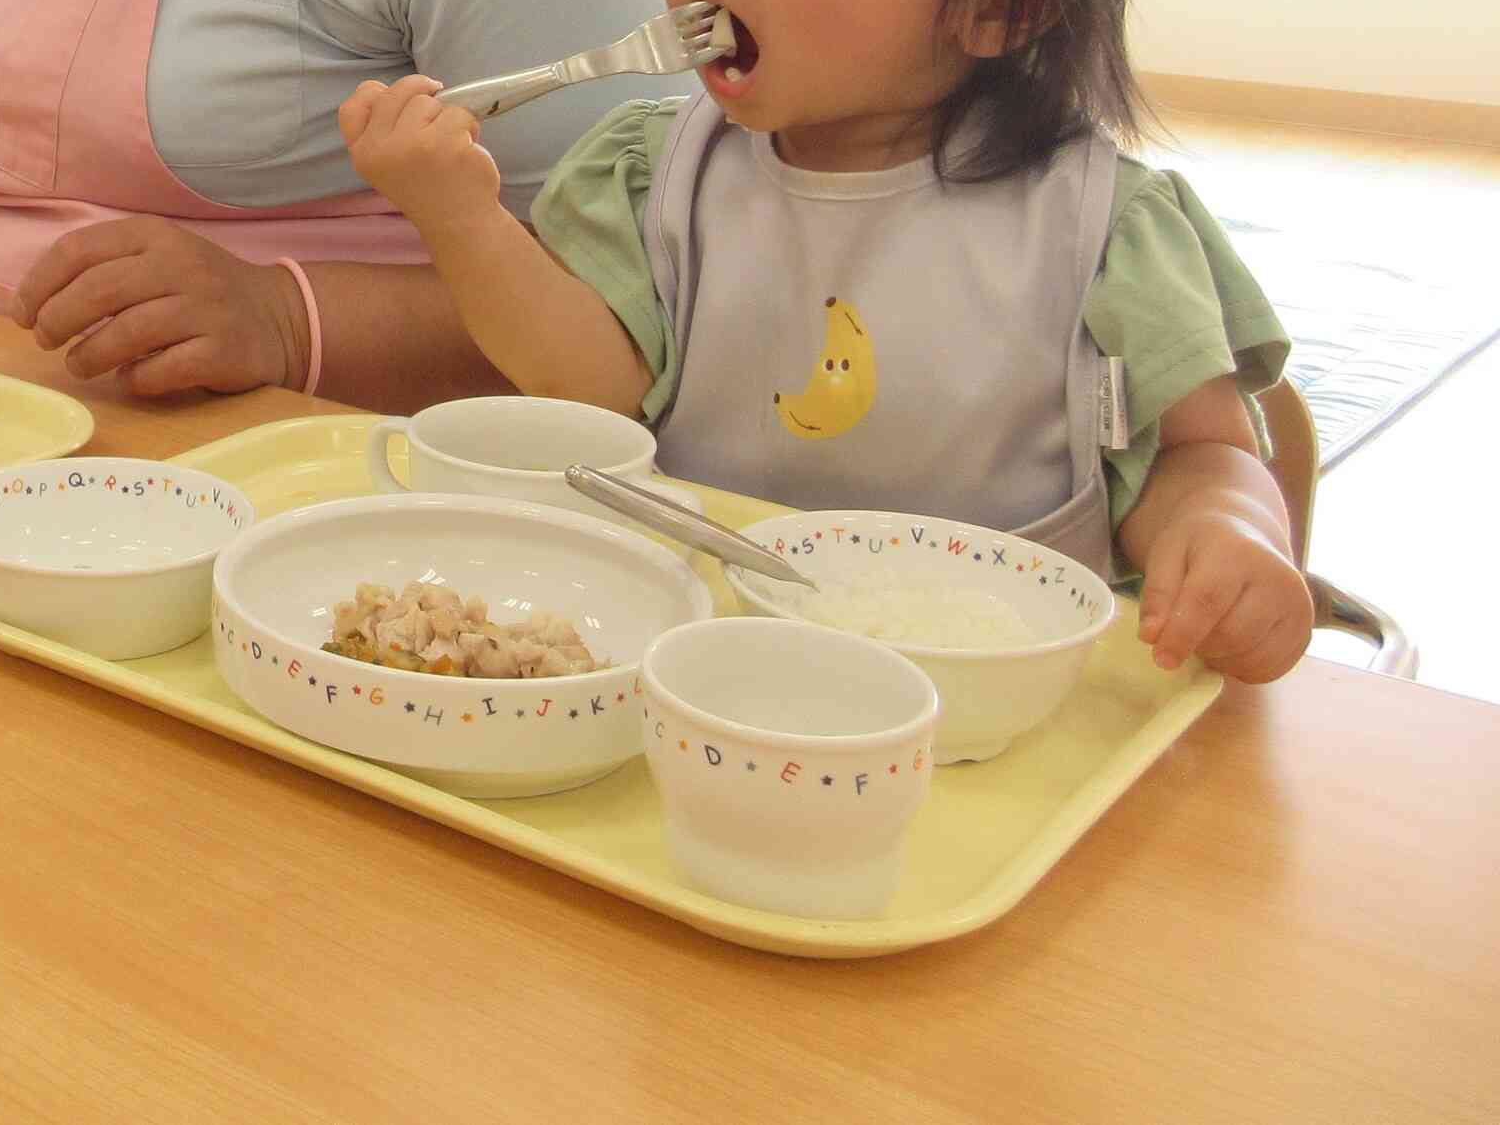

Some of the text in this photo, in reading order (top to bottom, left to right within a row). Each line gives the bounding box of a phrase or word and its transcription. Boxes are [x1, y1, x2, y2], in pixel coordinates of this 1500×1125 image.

[12, 478, 23, 493] O
[39, 483, 48, 497] P
[68, 472, 86, 488] Q
[104, 475, 116, 490] R
[133, 481, 145, 496] S
[164, 478, 173, 492] T
[186, 493, 197, 508] U
[212, 487, 221, 503] V
[774, 538, 786, 554] R
[802, 537, 814, 555] S
[834, 528, 845, 543] T
[869, 539, 883, 554] U
[911, 527, 924, 544] V
[947, 537, 969, 556] W
[991, 548, 1006, 566] X
[1029, 555, 1043, 572] Y
[1054, 567, 1066, 584] Z
[227, 630, 235, 644] C
[252, 641, 262, 659] D
[288, 659, 302, 678] E
[326, 685, 338, 704] F
[369, 688, 384, 706] G
[424, 705, 445, 726] H
[481, 697, 497, 716] I
[536, 698, 554, 717] J
[590, 695, 605, 715] K
[655, 722, 665, 739] C
[705, 744, 722, 766] D
[779, 761, 802, 784] E
[855, 773, 869, 796] F
